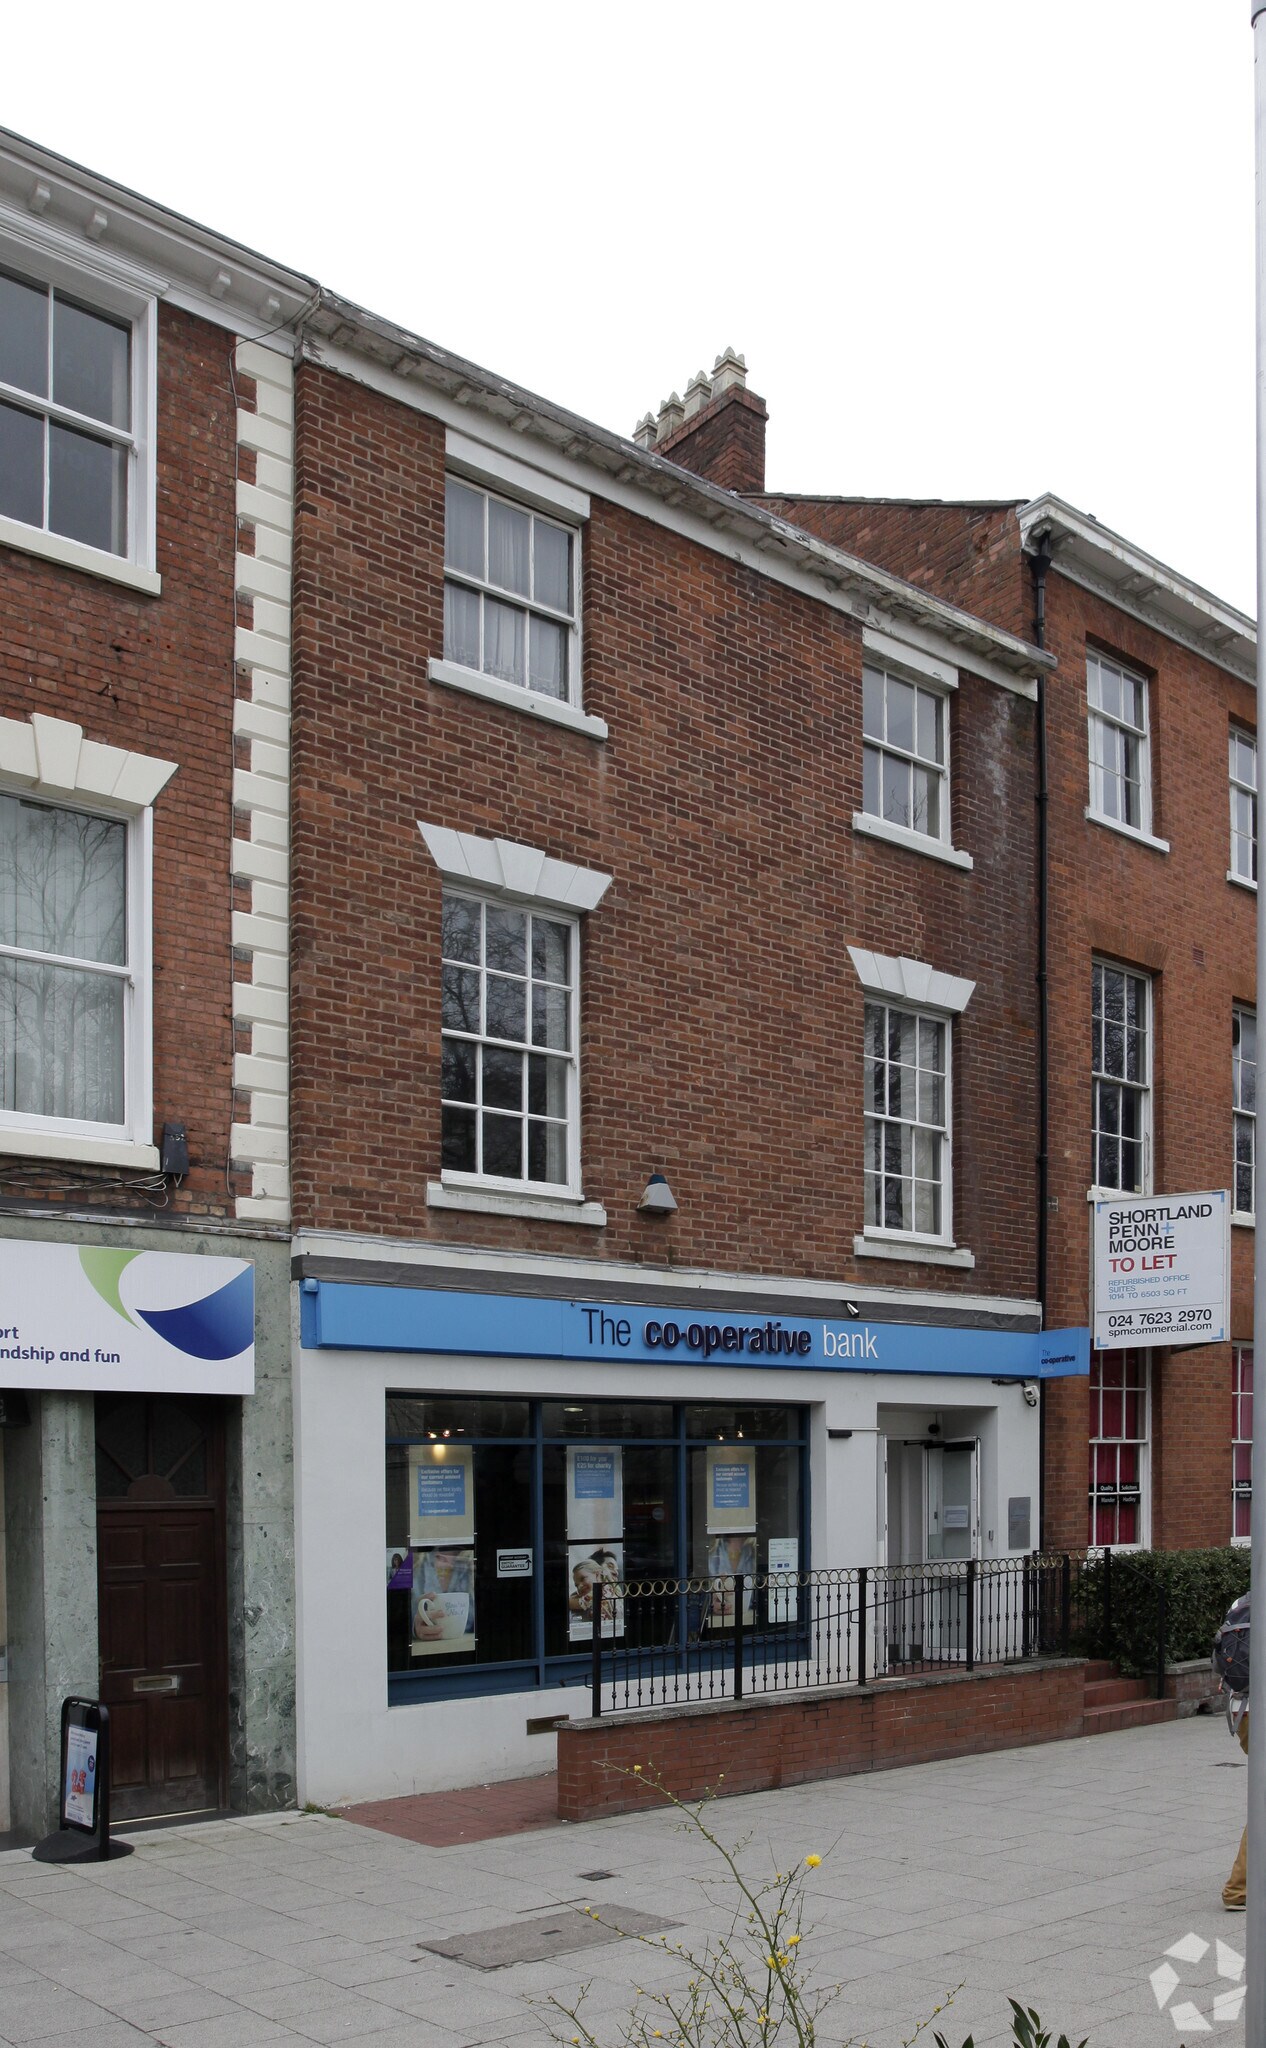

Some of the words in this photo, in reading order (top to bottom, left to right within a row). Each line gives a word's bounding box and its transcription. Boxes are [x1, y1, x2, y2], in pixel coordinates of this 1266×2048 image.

[1109, 1204, 1212, 1225] SHORTLAND
[1109, 1236, 1175, 1253] MOORE
[1109, 1257, 1135, 1273] TO
[1142, 1254, 1177, 1271] LET
[1108, 1276, 1160, 1287] REFURBISHED
[1163, 1274, 1190, 1283] OFFICE
[1108, 1285, 1136, 1294] SUITES
[1128, 1291, 1138, 1299] TO
[1141, 1290, 1161, 1298] 6503
[1164, 1289, 1176, 1297] SQ
[1108, 1315, 1133, 1328] 024
[1139, 1312, 1172, 1325] 7623
[1178, 1309, 1212, 1322] 2970
[581, 1308, 631, 1347] The
[823, 1324, 878, 1360] bank
[1108, 1322, 1212, 1338] spmcommercial.com
[60, 1349, 90, 1362] and
[94, 1349, 120, 1363] fun
